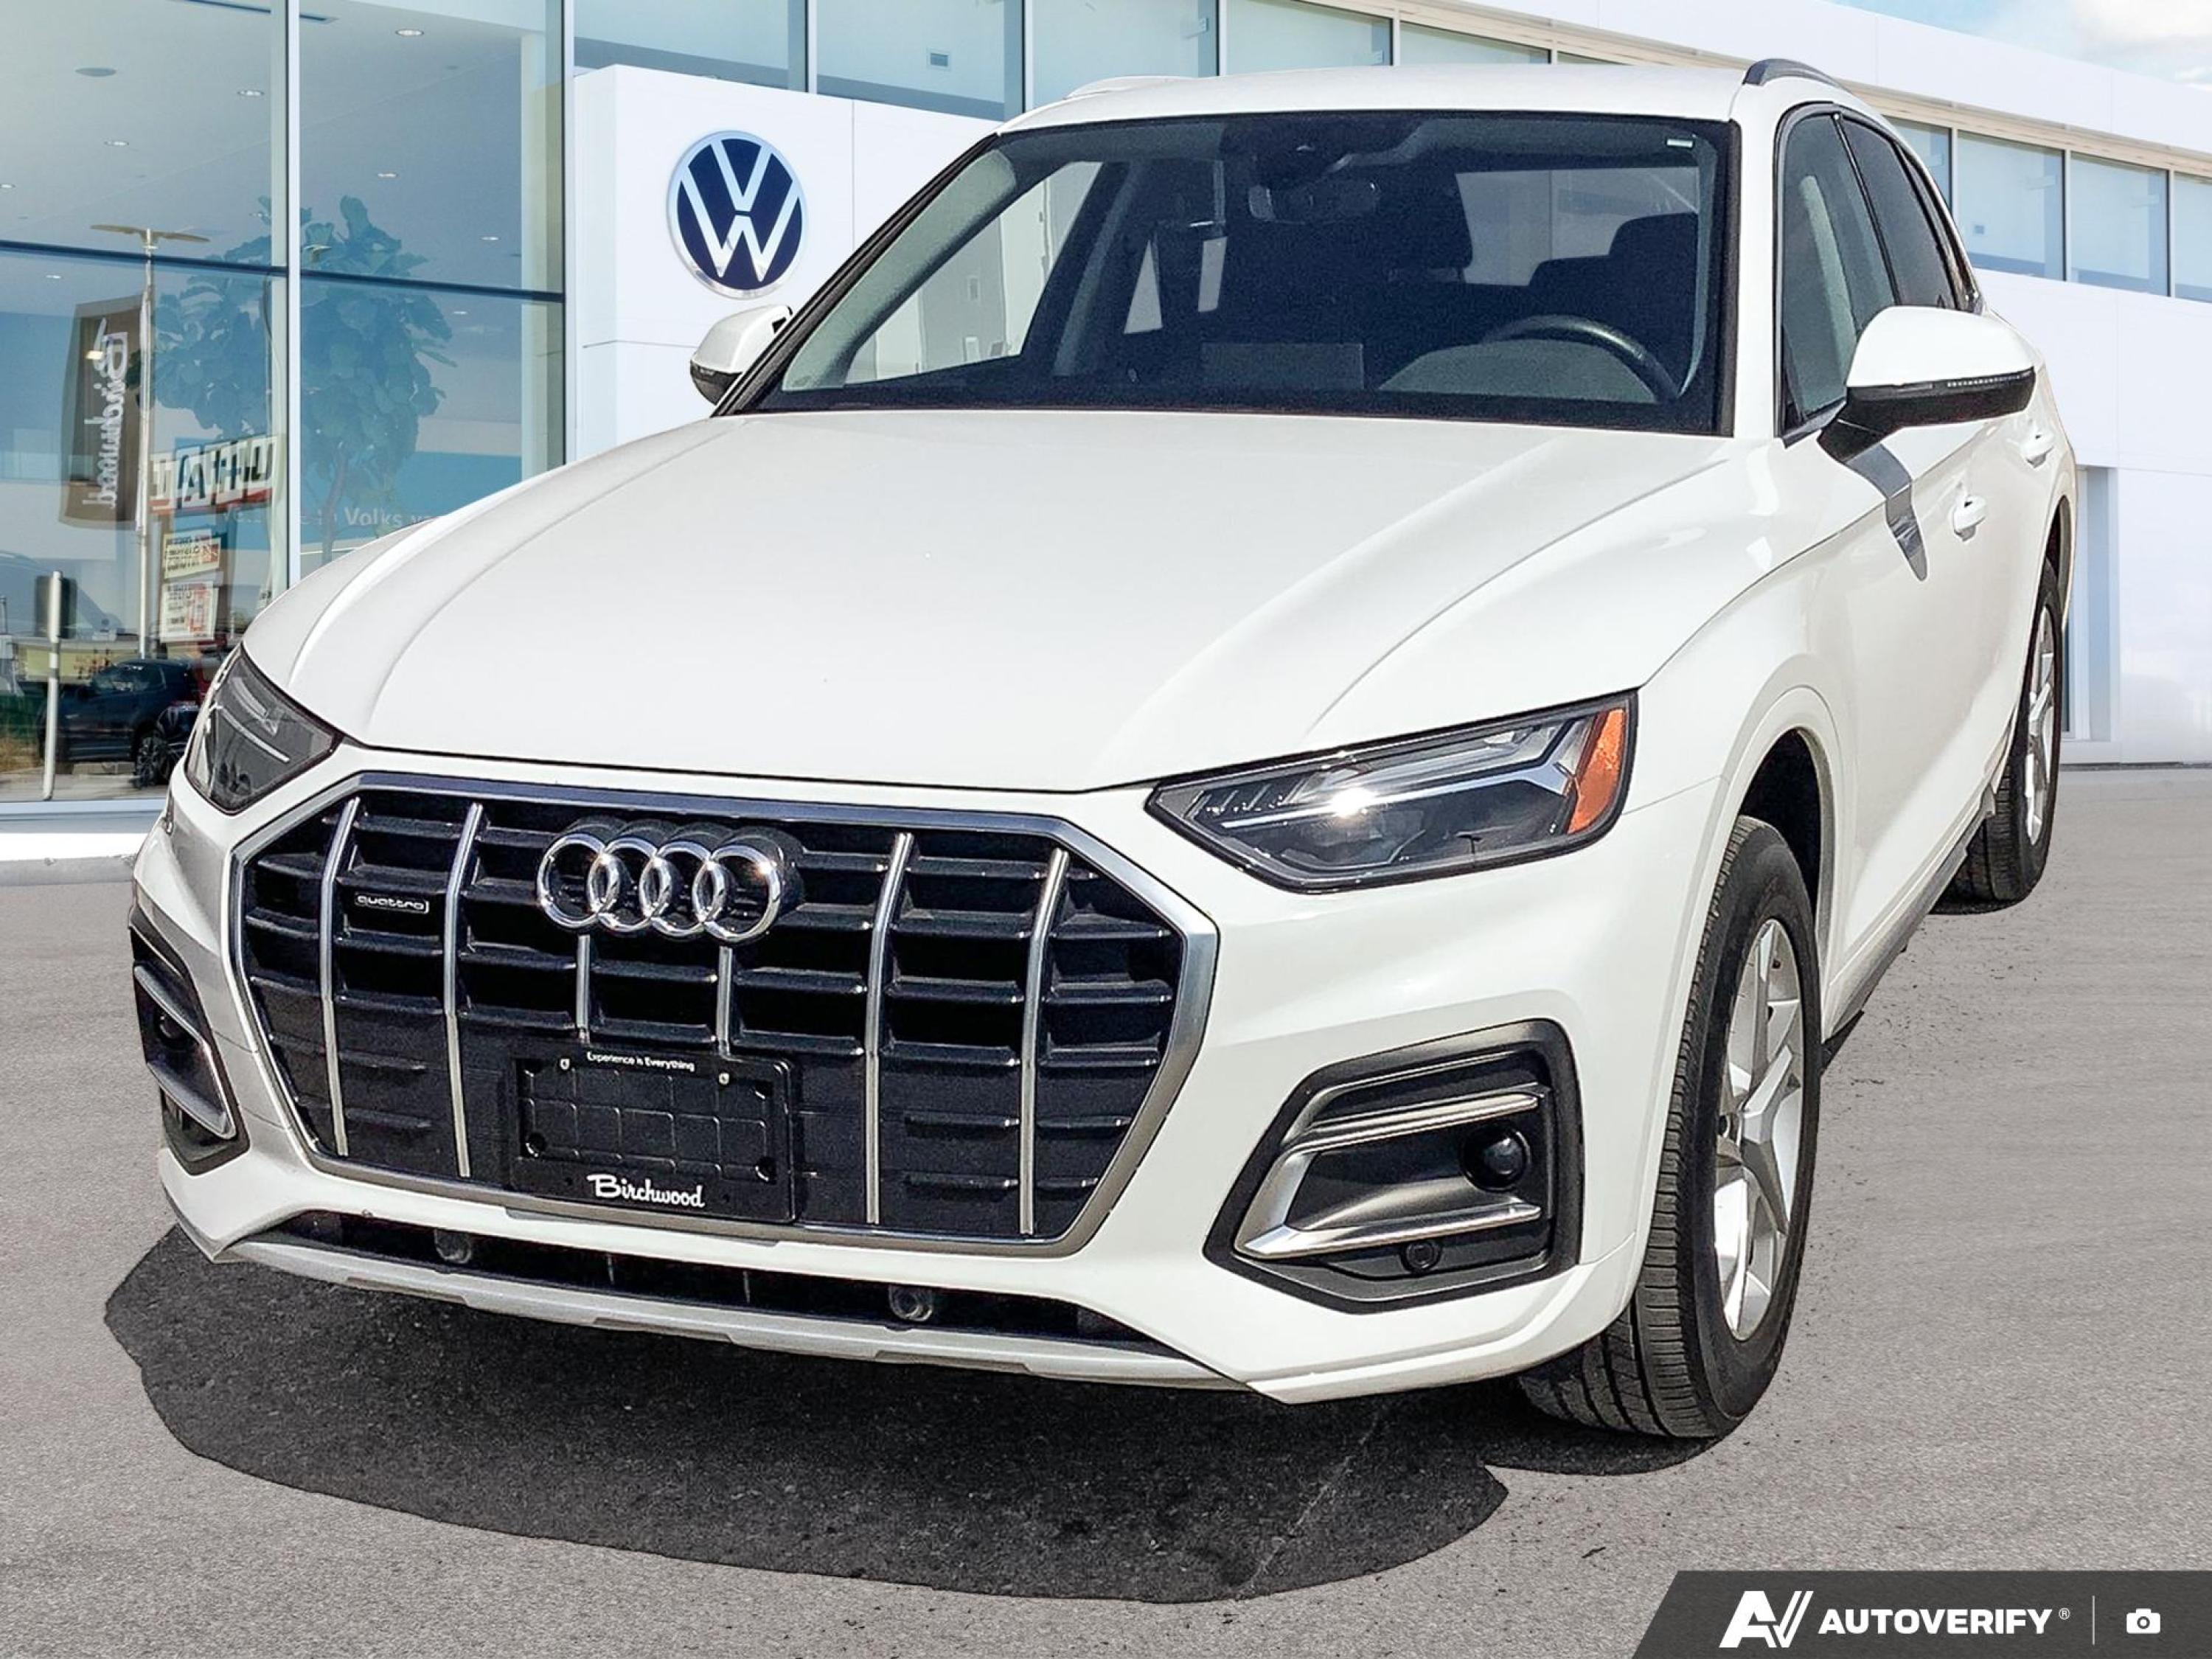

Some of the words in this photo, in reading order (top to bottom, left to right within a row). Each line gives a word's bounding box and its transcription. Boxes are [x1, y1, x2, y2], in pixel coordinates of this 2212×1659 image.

[357, 894, 425, 911] quattro
[644, 1057, 696, 1073] Everything
[587, 1174, 706, 1208] Birchwood
